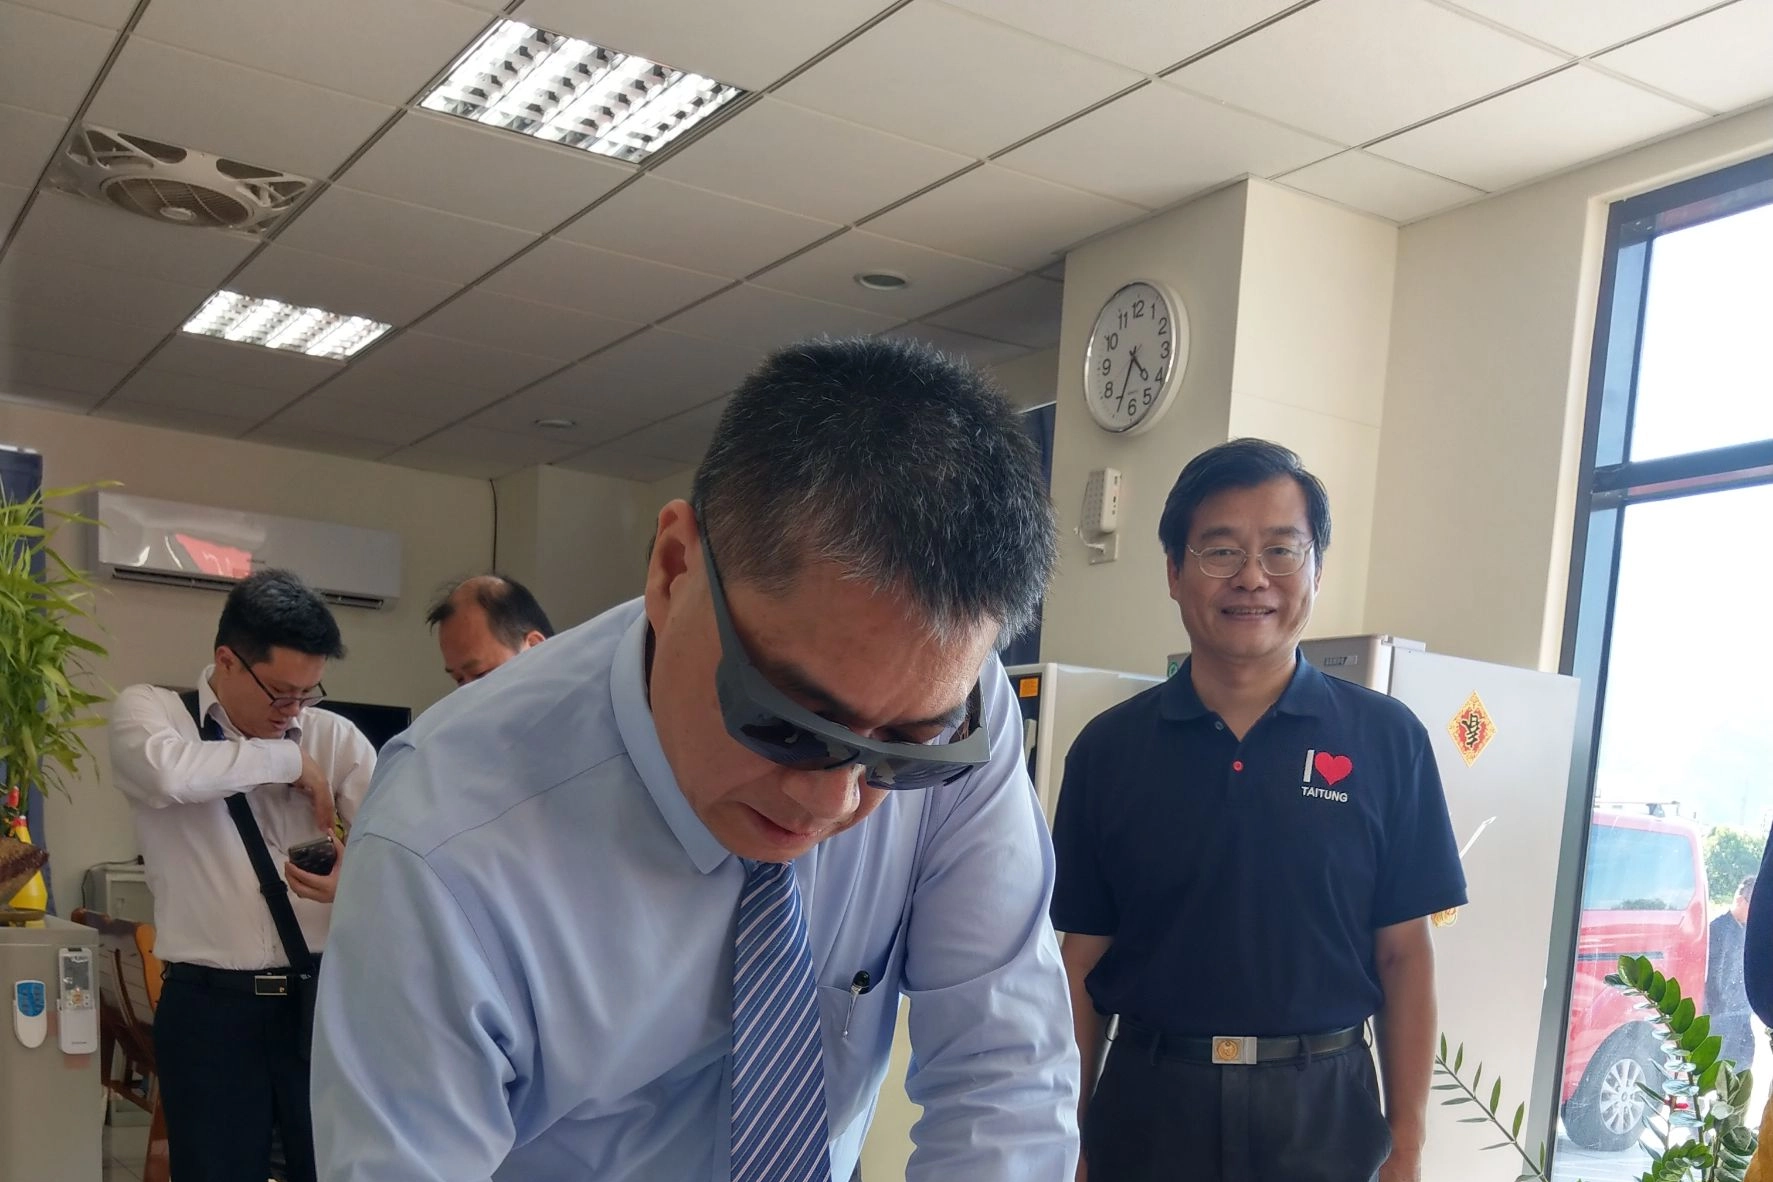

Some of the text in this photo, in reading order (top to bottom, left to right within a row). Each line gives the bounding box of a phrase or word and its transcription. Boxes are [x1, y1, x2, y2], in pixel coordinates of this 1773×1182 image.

[1132, 300, 1145, 319] 12
[1118, 311, 1128, 330] 11
[1158, 317, 1167, 335] 2
[1105, 332, 1119, 351] 10
[1160, 341, 1170, 359] 3
[1102, 358, 1111, 376] 9
[1155, 367, 1164, 384] 4
[1104, 381, 1113, 399] 8
[1143, 387, 1152, 405] 5
[1127, 398, 1137, 416] 6
[1303, 749, 1315, 783] I
[1301, 786, 1348, 803] TAITUNG
